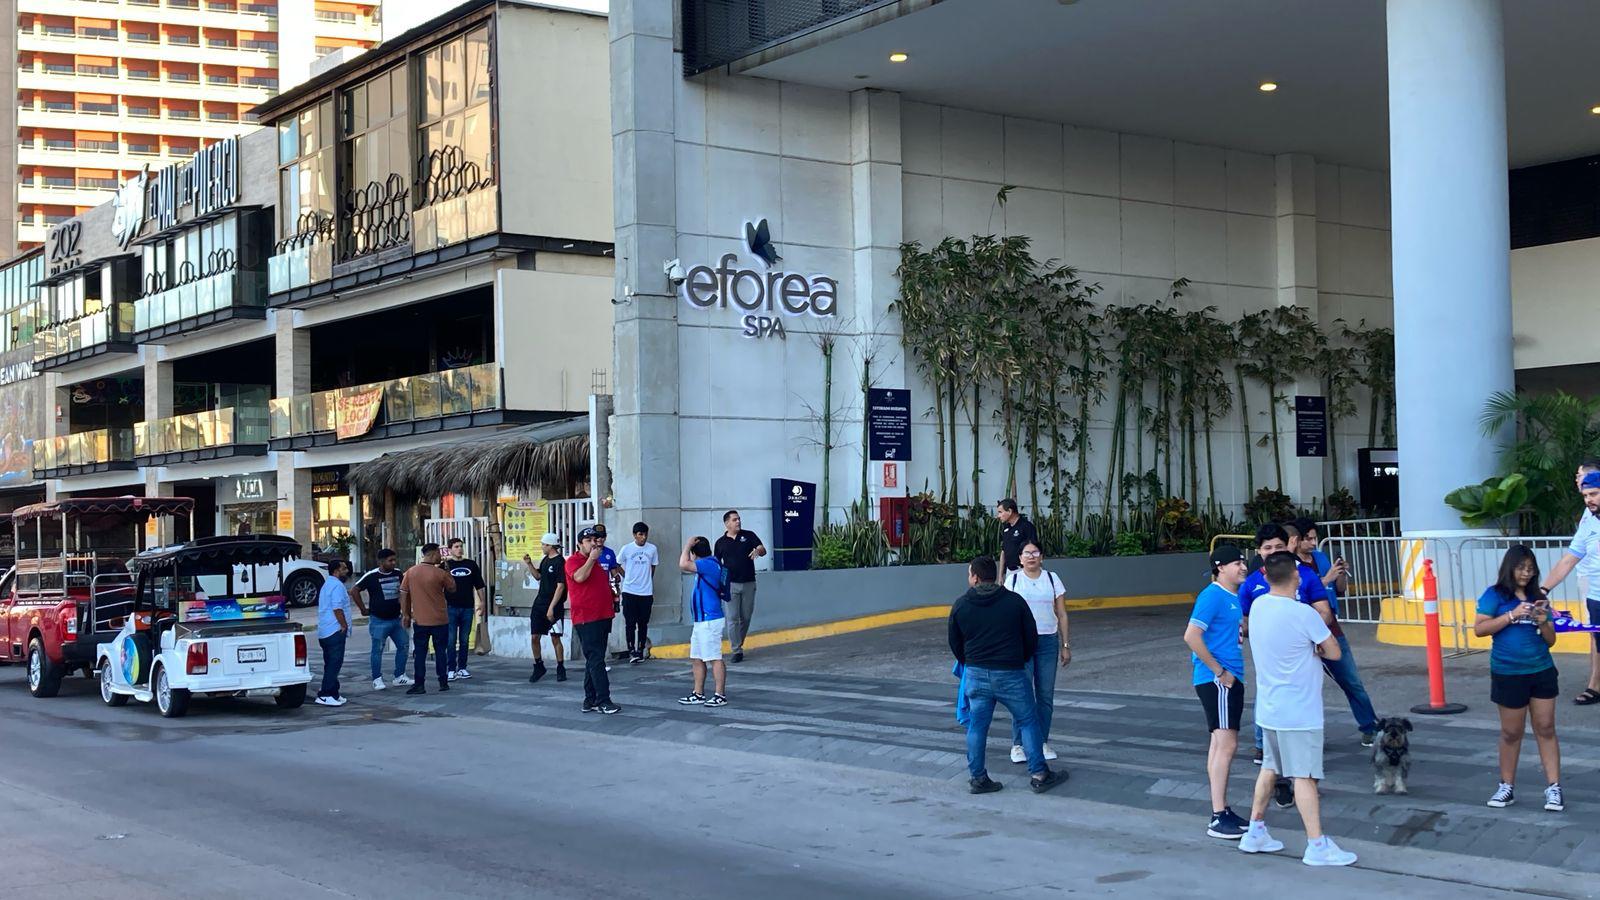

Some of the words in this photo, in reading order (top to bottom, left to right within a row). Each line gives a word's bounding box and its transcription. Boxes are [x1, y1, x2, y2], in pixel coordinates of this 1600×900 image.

[158, 163, 177, 231] MAL
[193, 136, 238, 217] PUERCO
[51, 220, 82, 263] 202
[685, 253, 837, 316] eforea
[743, 315, 786, 341] SPA
[338, 397, 349, 411] SE
[344, 407, 370, 424] LOCA
